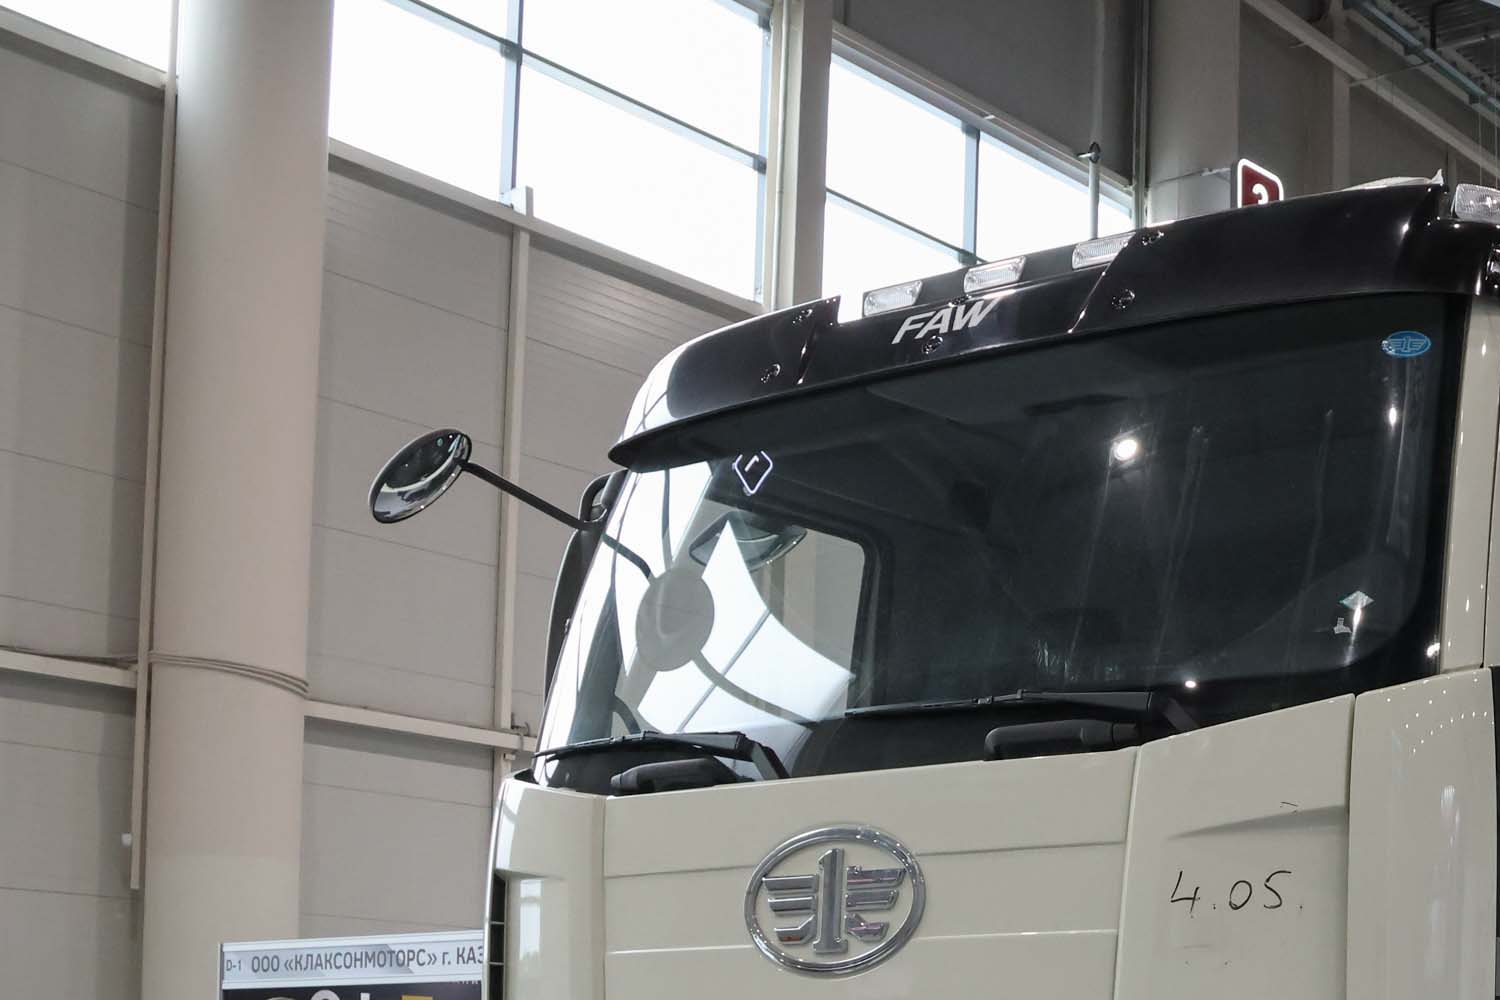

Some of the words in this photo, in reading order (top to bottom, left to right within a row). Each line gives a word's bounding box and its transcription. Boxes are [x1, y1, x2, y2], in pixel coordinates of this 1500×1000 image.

[891, 296, 1000, 345] FAW
[251, 955, 280, 973] ООО
[284, 948, 437, 971] «КЛАКСОНМОТОРС»
